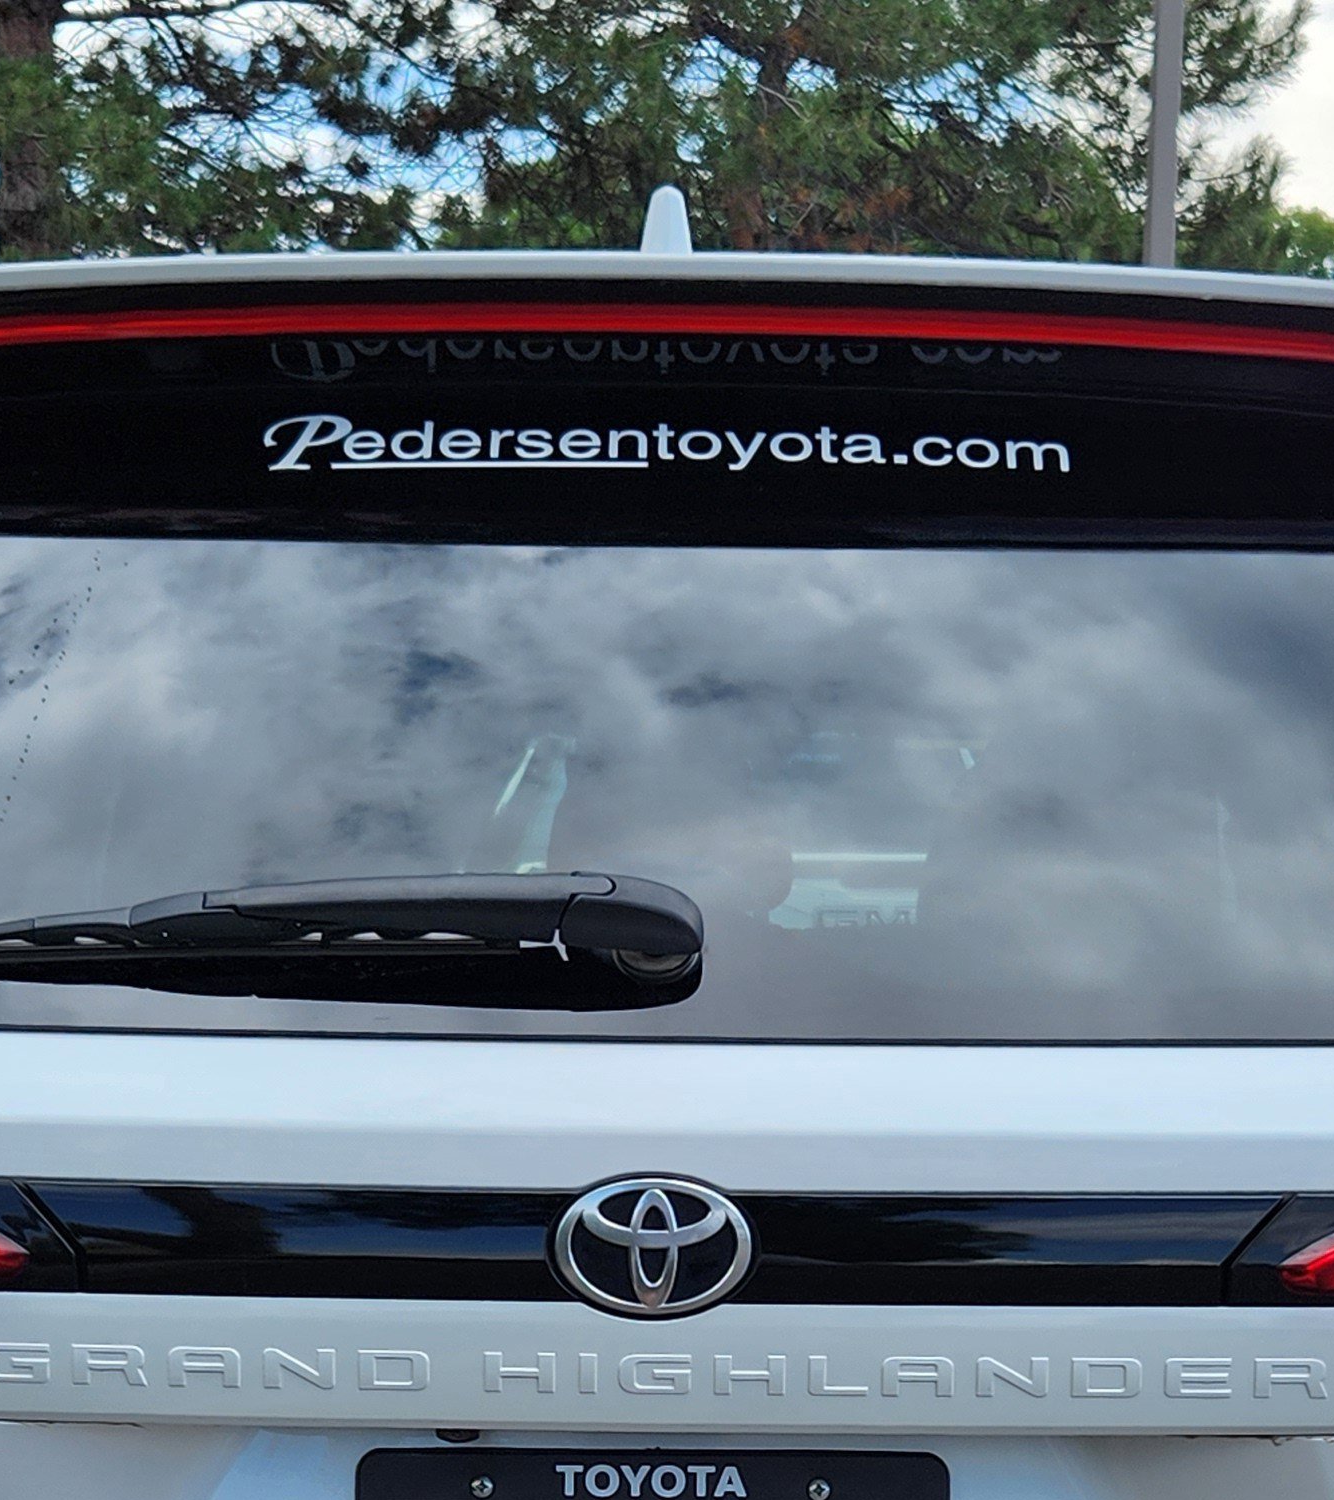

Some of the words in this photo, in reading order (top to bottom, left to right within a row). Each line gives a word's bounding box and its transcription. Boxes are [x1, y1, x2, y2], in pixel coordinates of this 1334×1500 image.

[263, 414, 1071, 473] Pedersentoyota.com
[481, 1350, 1329, 1399] HIGHLANDER
[554, 1463, 748, 1499] TOYOTA
